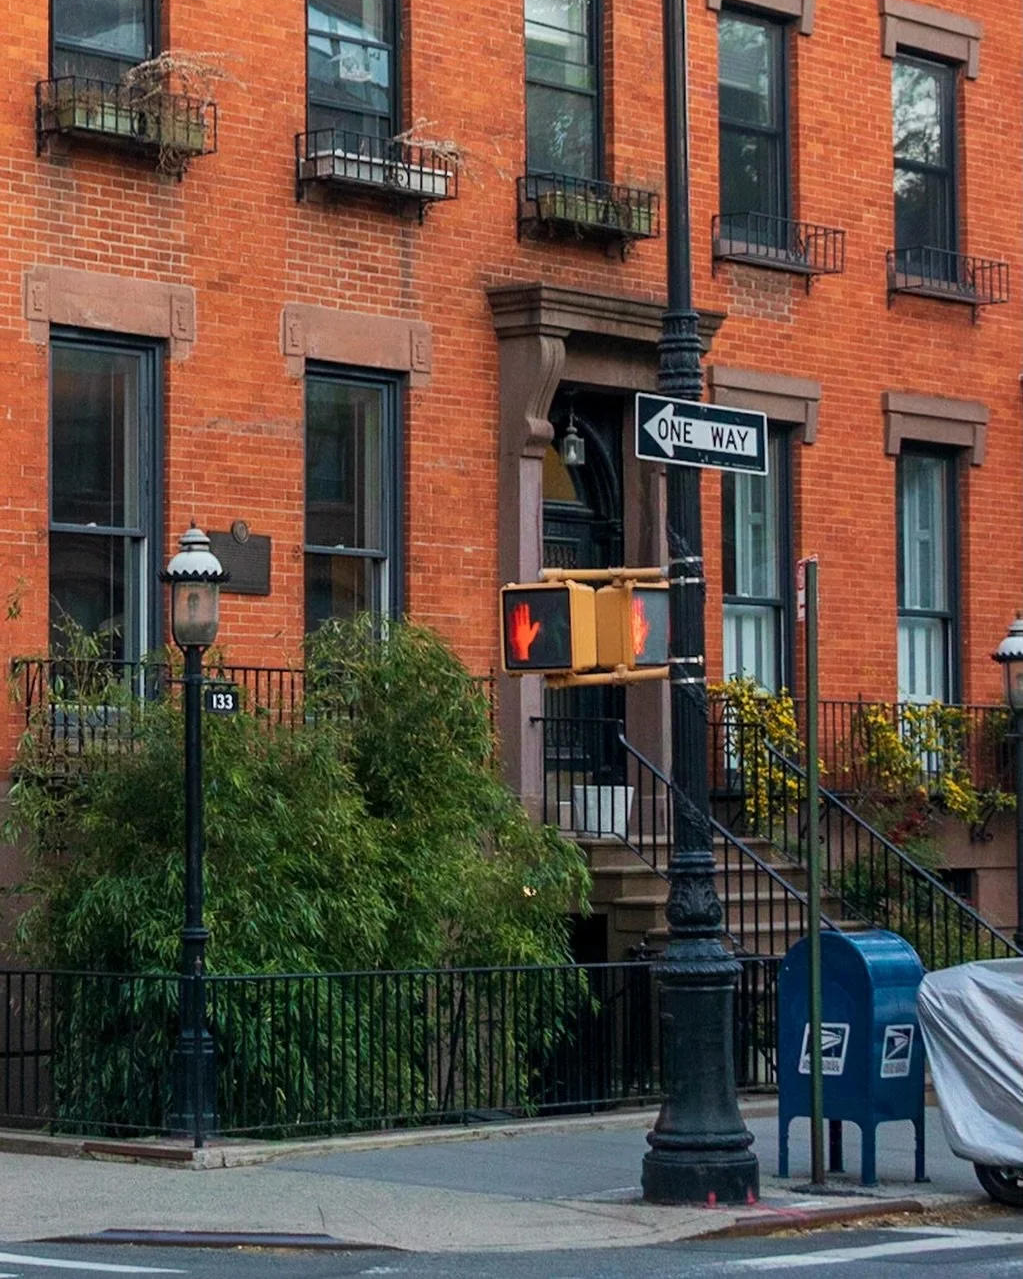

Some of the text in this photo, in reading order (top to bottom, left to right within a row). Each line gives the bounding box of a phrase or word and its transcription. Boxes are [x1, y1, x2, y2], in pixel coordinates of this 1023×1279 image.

[657, 418, 748, 451] ONE WAY
[212, 693, 234, 710] 133
